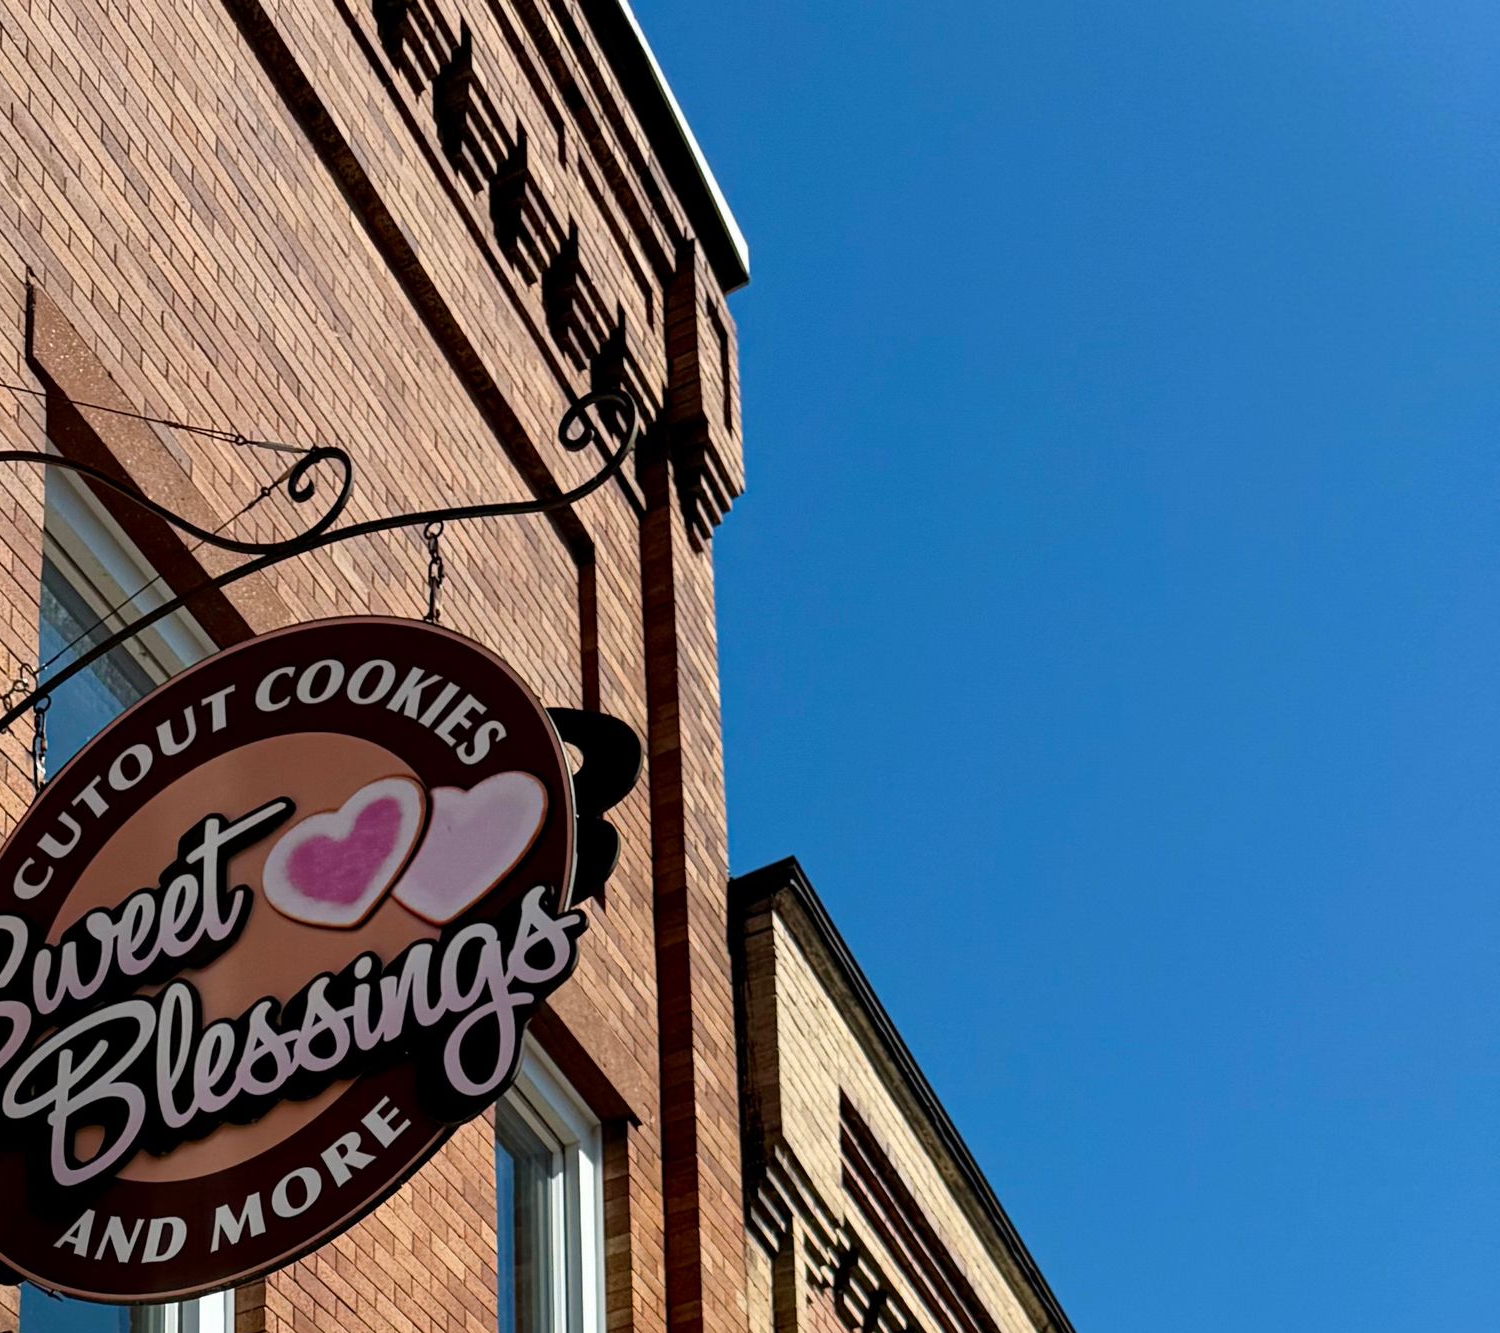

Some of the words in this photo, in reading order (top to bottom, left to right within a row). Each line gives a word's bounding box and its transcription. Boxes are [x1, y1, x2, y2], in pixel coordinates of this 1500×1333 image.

[14, 686, 235, 900] CUTOUT
[254, 658, 508, 766] COOKIES
[2, 885, 581, 1187] Blessings
[55, 1207, 187, 1264] AND
[210, 1096, 412, 1253] MORE
